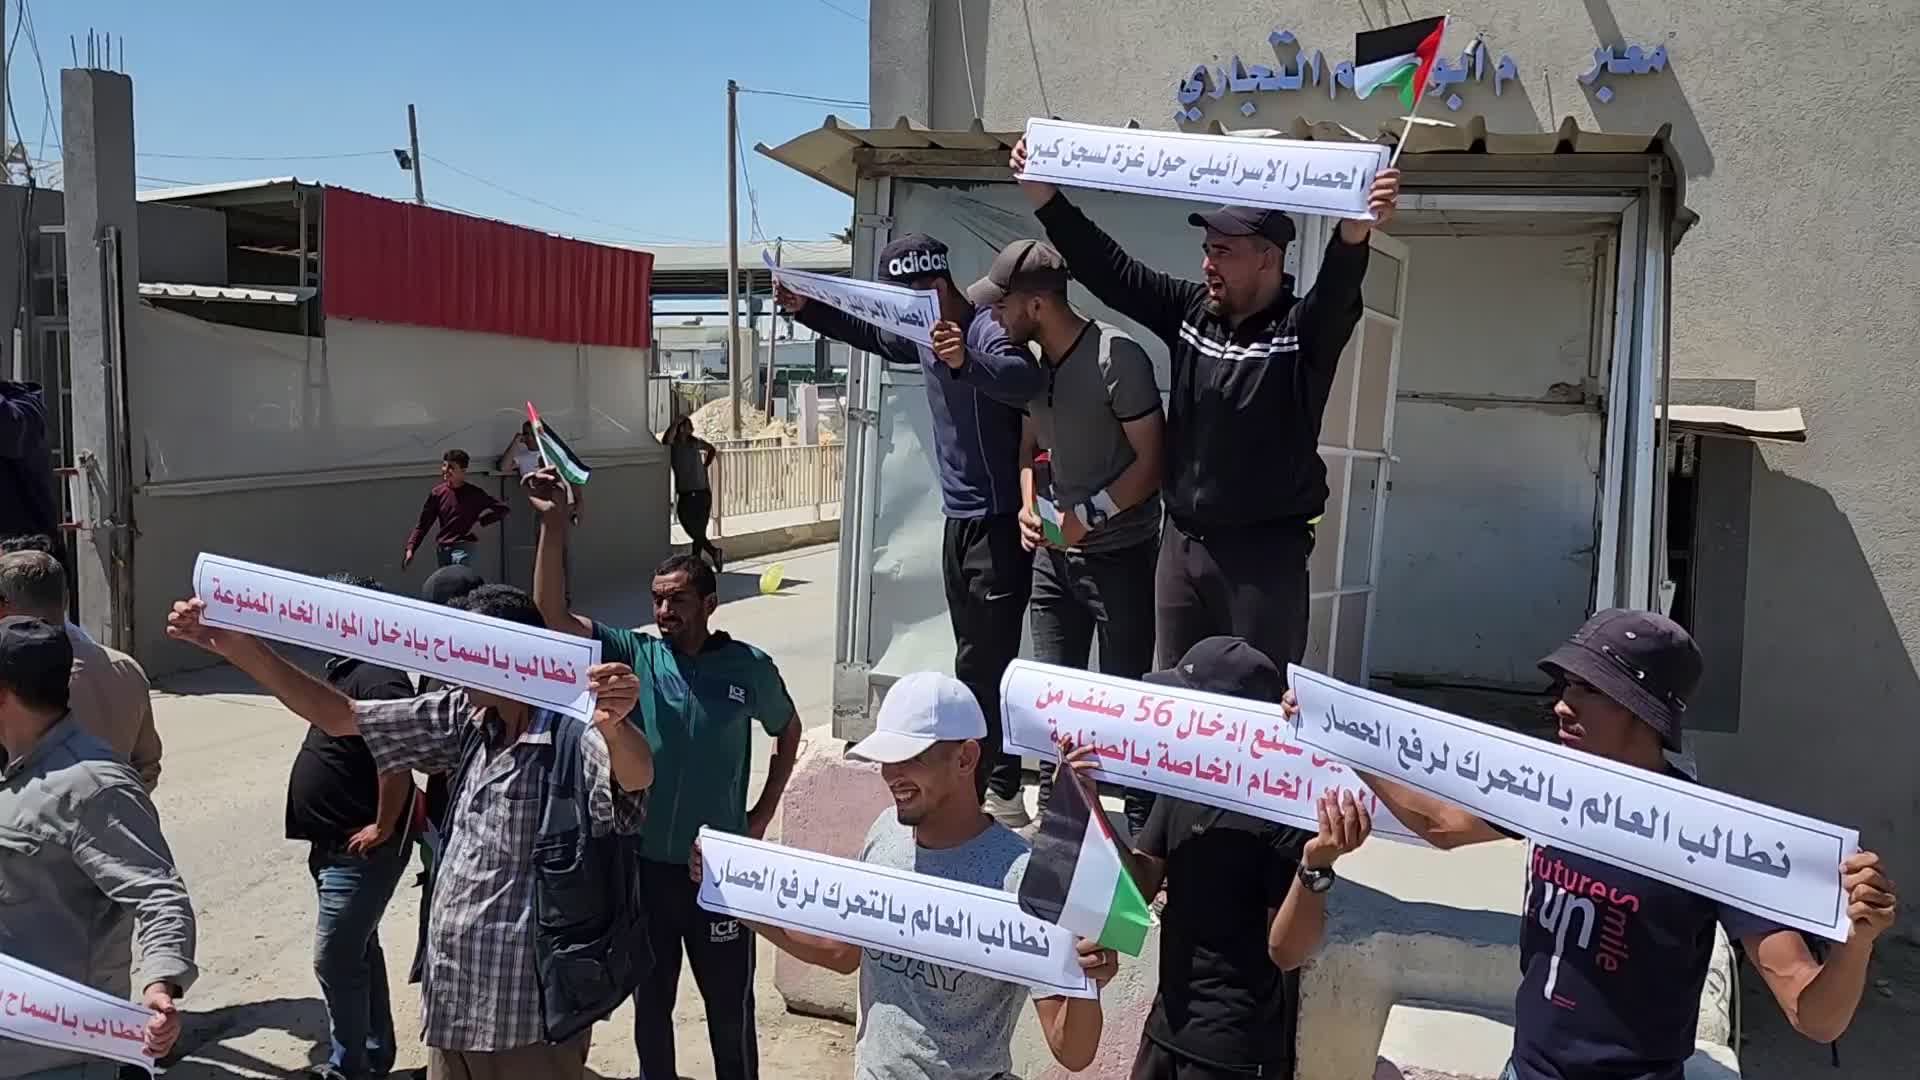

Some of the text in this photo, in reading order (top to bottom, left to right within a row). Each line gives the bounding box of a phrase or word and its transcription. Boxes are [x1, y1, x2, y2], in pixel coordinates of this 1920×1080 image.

[1174, 30, 1321, 123] التجاري
[1576, 42, 1667, 103] معبر
[1111, 144, 1145, 173] غزة
[1147, 148, 1186, 178] حول
[1288, 161, 1367, 193] الحصار
[888, 250, 948, 276] adidas
[278, 598, 320, 626] الخام
[325, 609, 363, 640] المواد
[367, 620, 429, 660] بإدخال
[433, 635, 510, 680] بالسماح
[514, 656, 578, 686] نطالب
[1035, 681, 1064, 710] من
[1067, 687, 1125, 718] صنف
[1134, 695, 1176, 727] 56
[1175, 709, 1246, 753] إدخال
[1321, 704, 1391, 750] الحصار
[1156, 741, 1241, 787] الخاصة
[1397, 727, 1450, 774] لرفع
[1247, 768, 1312, 801] الخام
[1455, 749, 1574, 825] بالتحرك
[1579, 790, 1670, 844] العالم
[1678, 824, 1791, 880] نطالب
[712, 857, 1050, 958] نطالب العالم بالتحرك لرفع الحصار
[5, 992, 78, 1036] بالسماح
